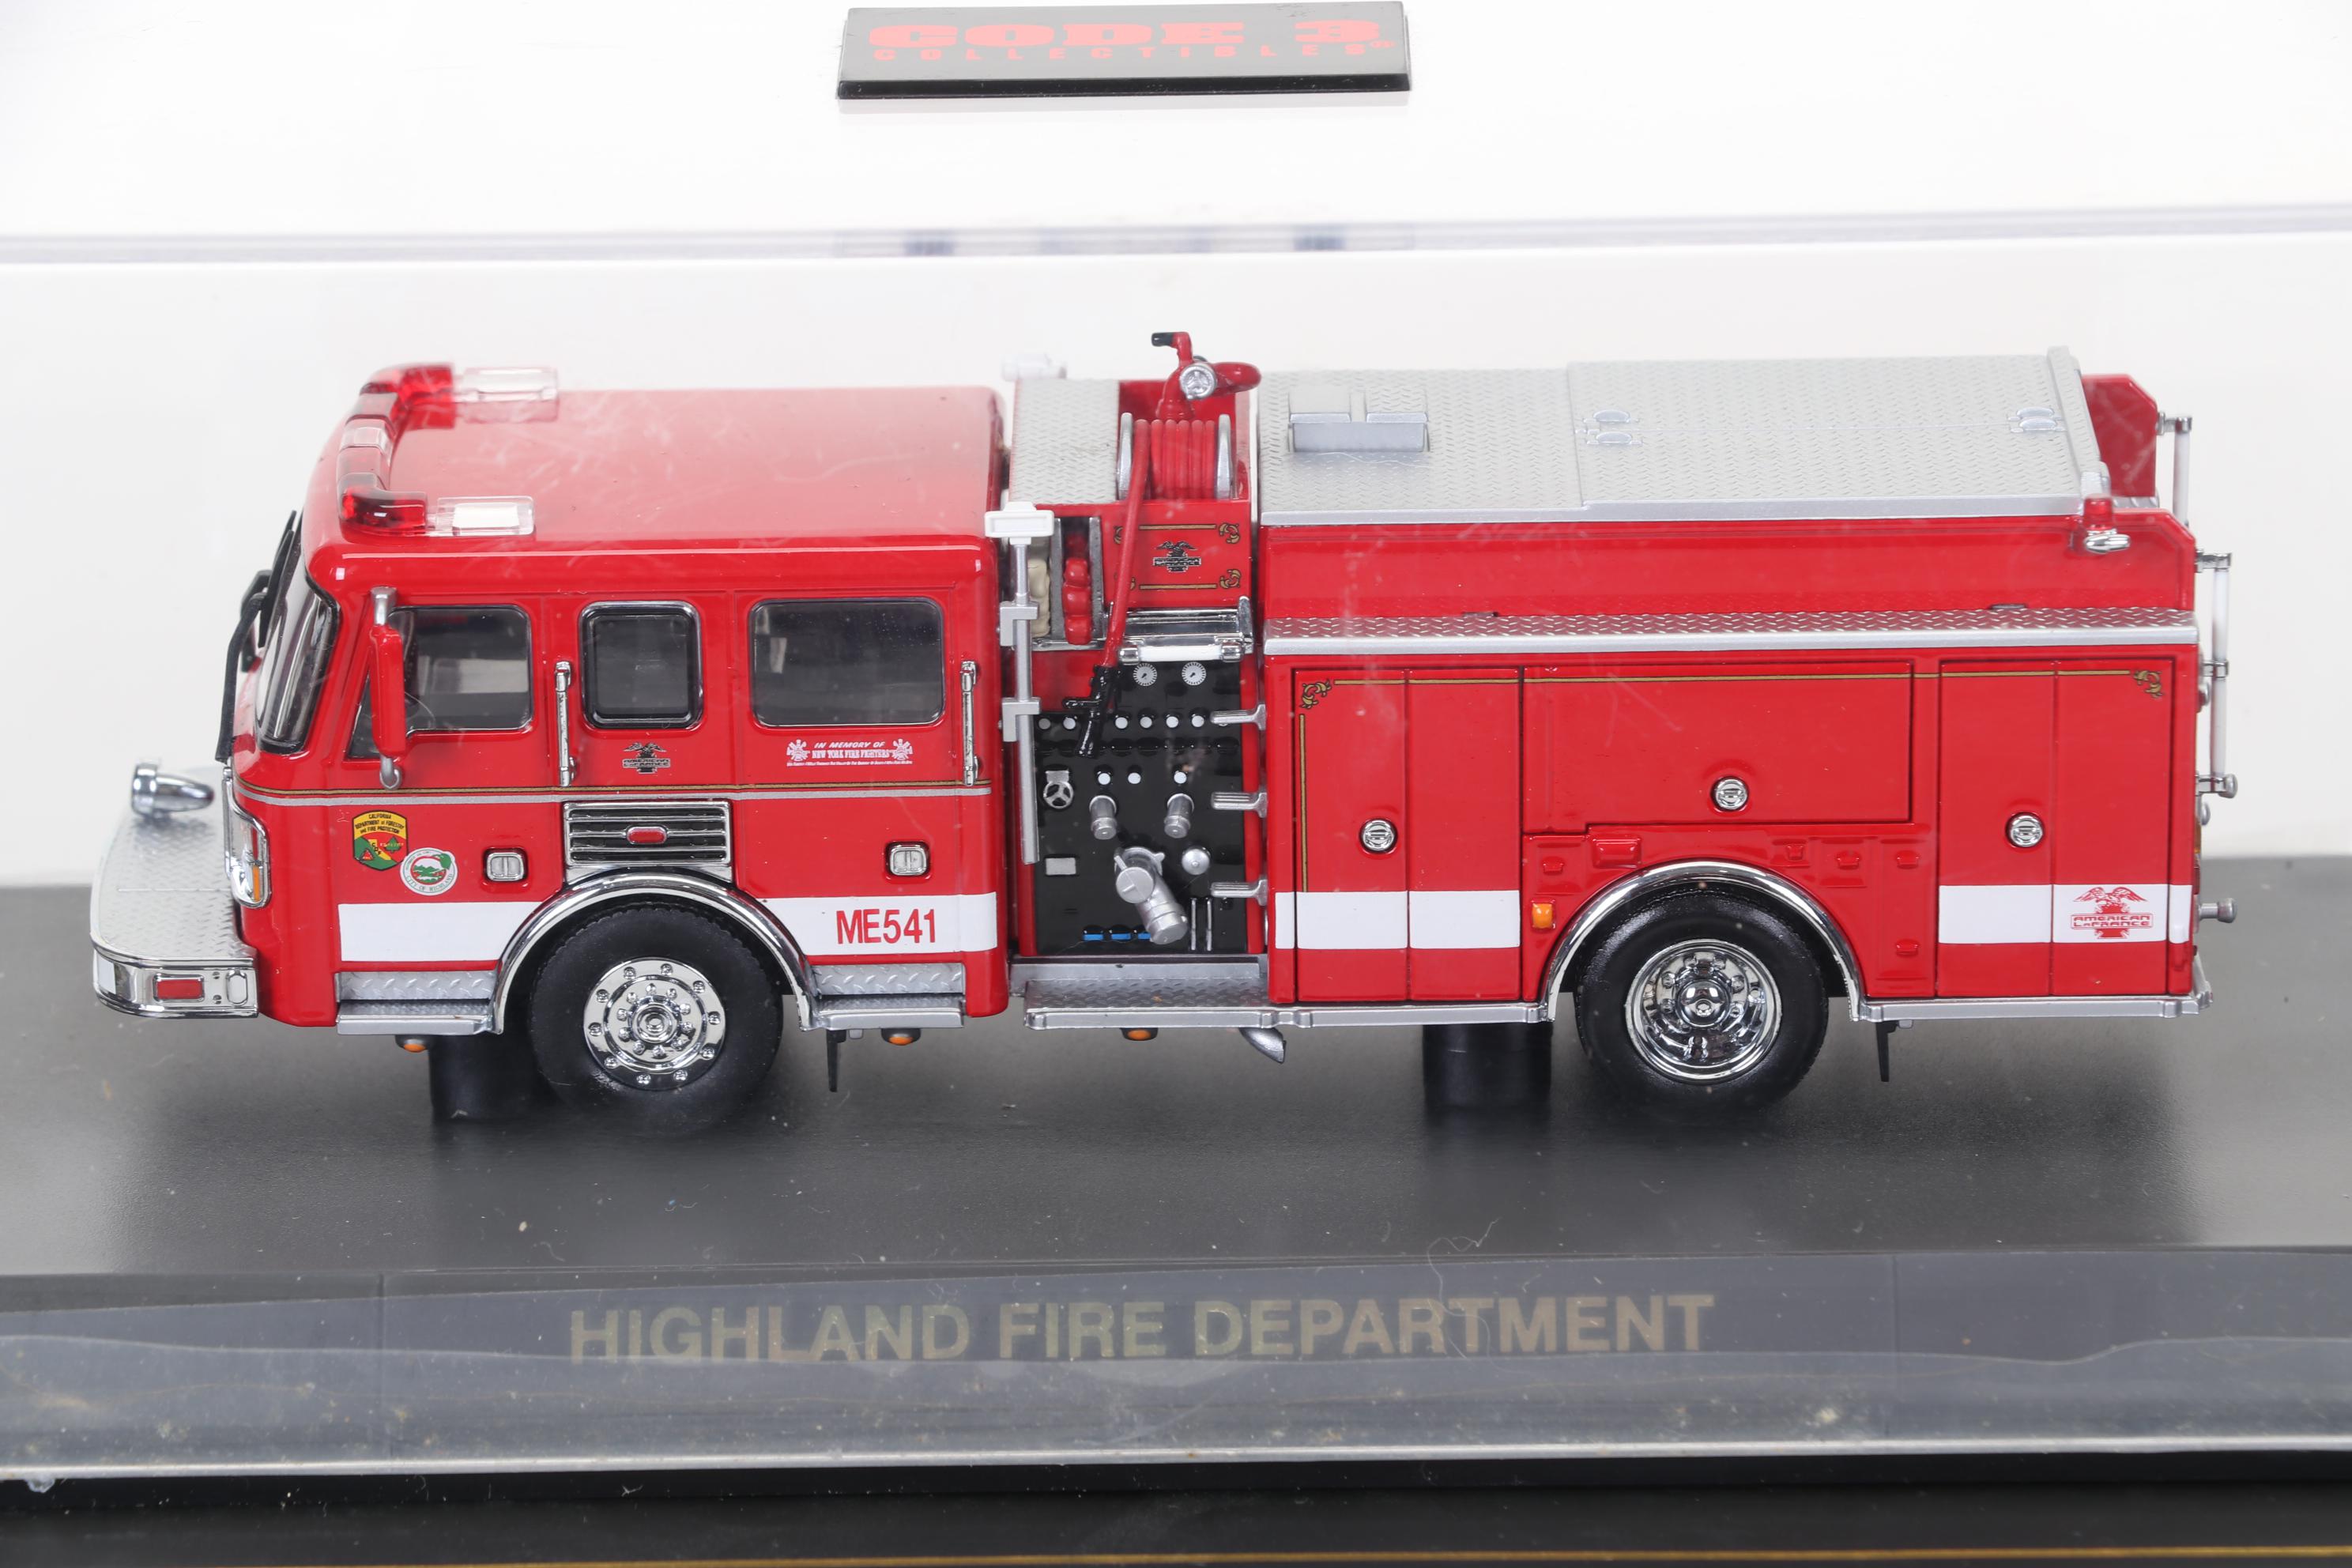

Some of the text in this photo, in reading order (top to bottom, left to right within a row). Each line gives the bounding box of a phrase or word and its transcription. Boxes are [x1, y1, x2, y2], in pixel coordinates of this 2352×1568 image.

[869, 20, 1380, 48] CODE 3
[873, 43, 1366, 62] COLLECTIBLES
[812, 750, 826, 759] NEW
[827, 750, 843, 759] YORK
[845, 749, 860, 758] FIRE
[836, 908, 936, 944] ME541
[569, 1294, 1715, 1364] HIGHLAND FIRE DEPARTMENT
